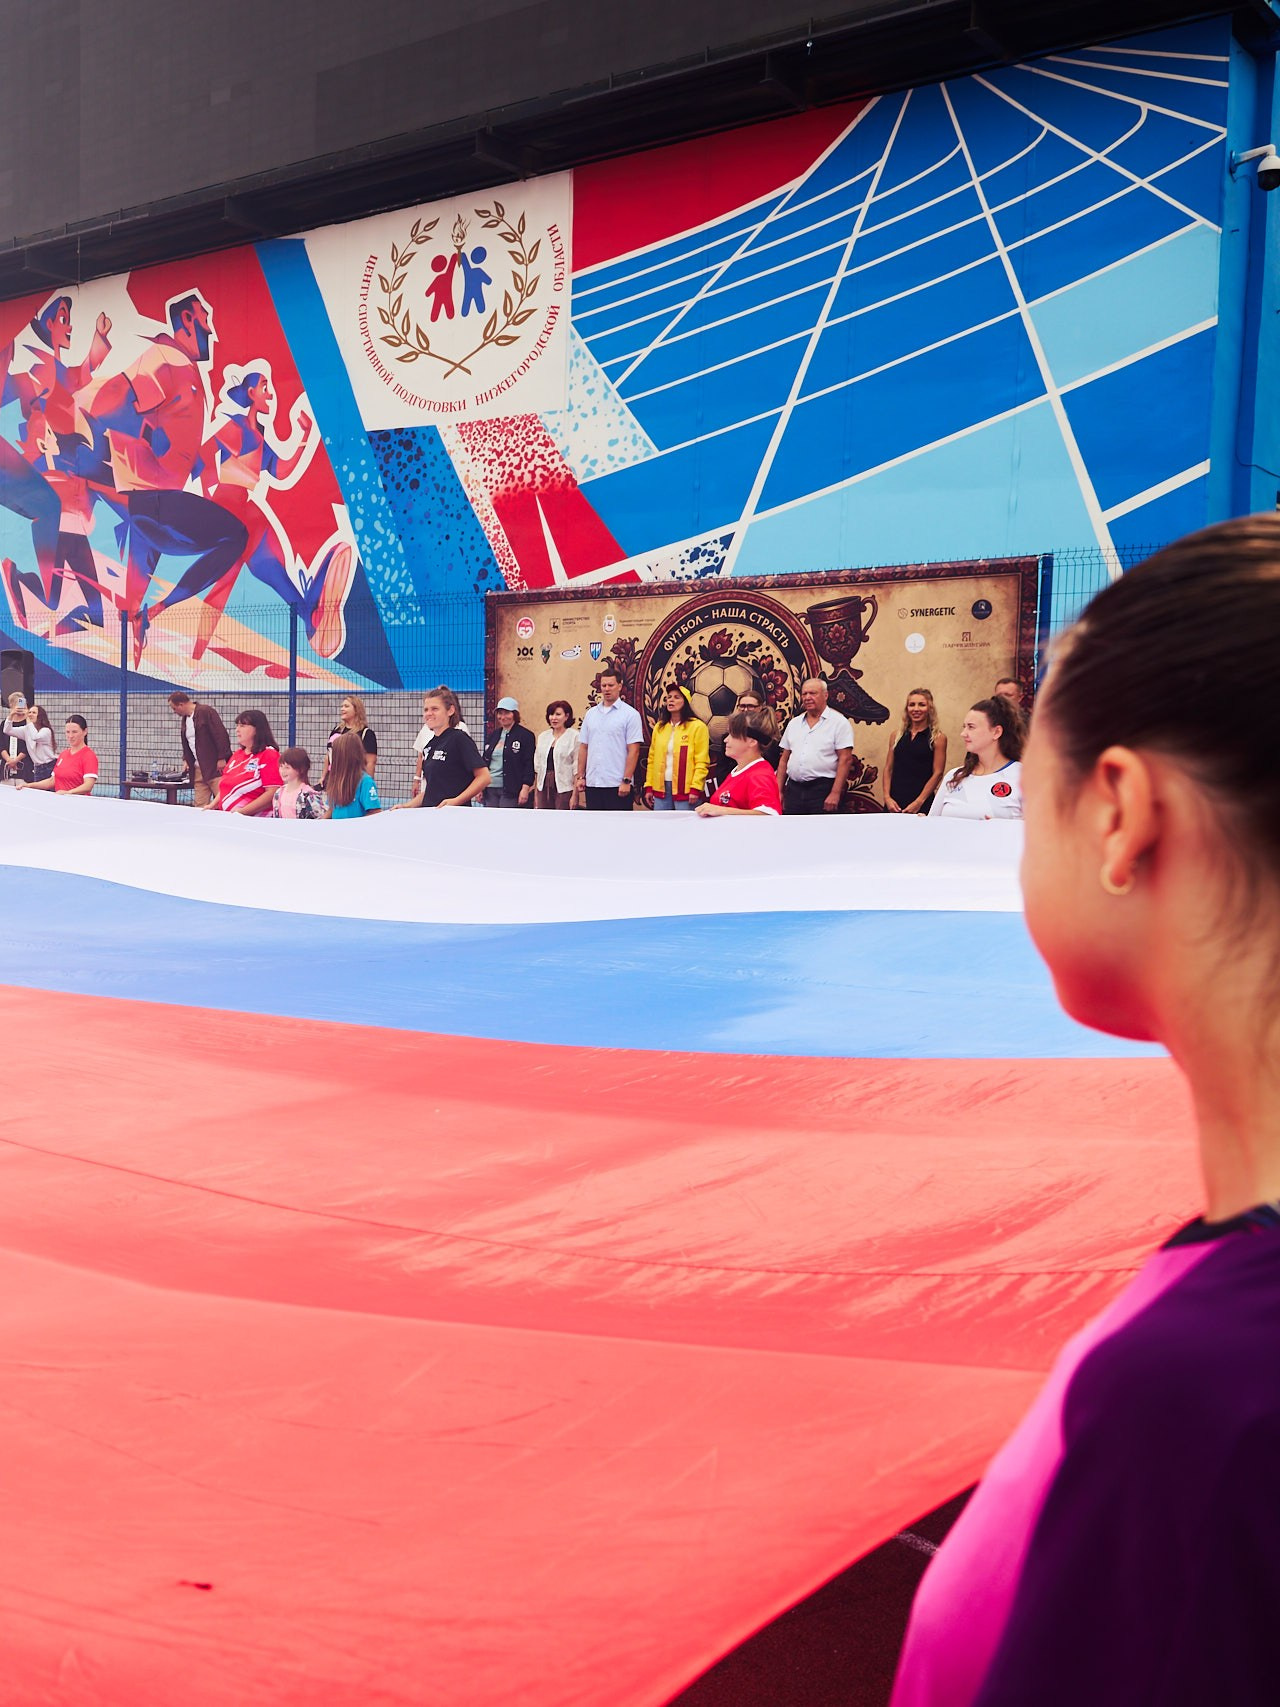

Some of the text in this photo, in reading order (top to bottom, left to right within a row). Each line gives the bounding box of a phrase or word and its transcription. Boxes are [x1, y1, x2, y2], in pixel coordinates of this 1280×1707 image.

[358, 223, 566, 413] ЦЕНТР СПОРТИВНОЙ ПОДГОТОВКИ НИЖЕГОРОДСКОЙ ОБЛАСТИ
[663, 615, 703, 651] ФУТБОЛ
[712, 607, 747, 619] НАША
[749, 612, 790, 648] СТРАСТЬ
[910, 606, 956, 617] SYNERGETIC
